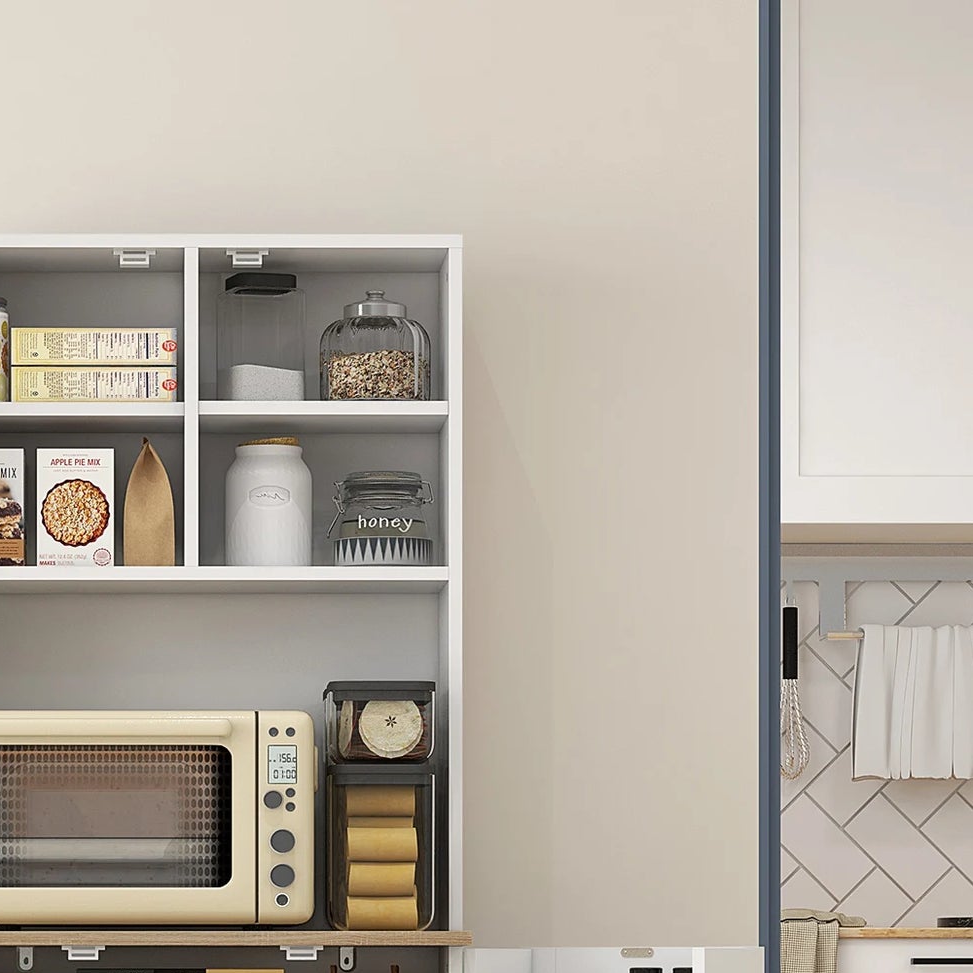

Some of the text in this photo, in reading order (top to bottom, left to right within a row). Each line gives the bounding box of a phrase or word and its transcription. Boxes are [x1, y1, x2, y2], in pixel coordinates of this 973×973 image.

[50, 458, 101, 466] APPLE PIE MIX
[1, 467, 17, 479] MIX
[358, 514, 413, 533] honey
